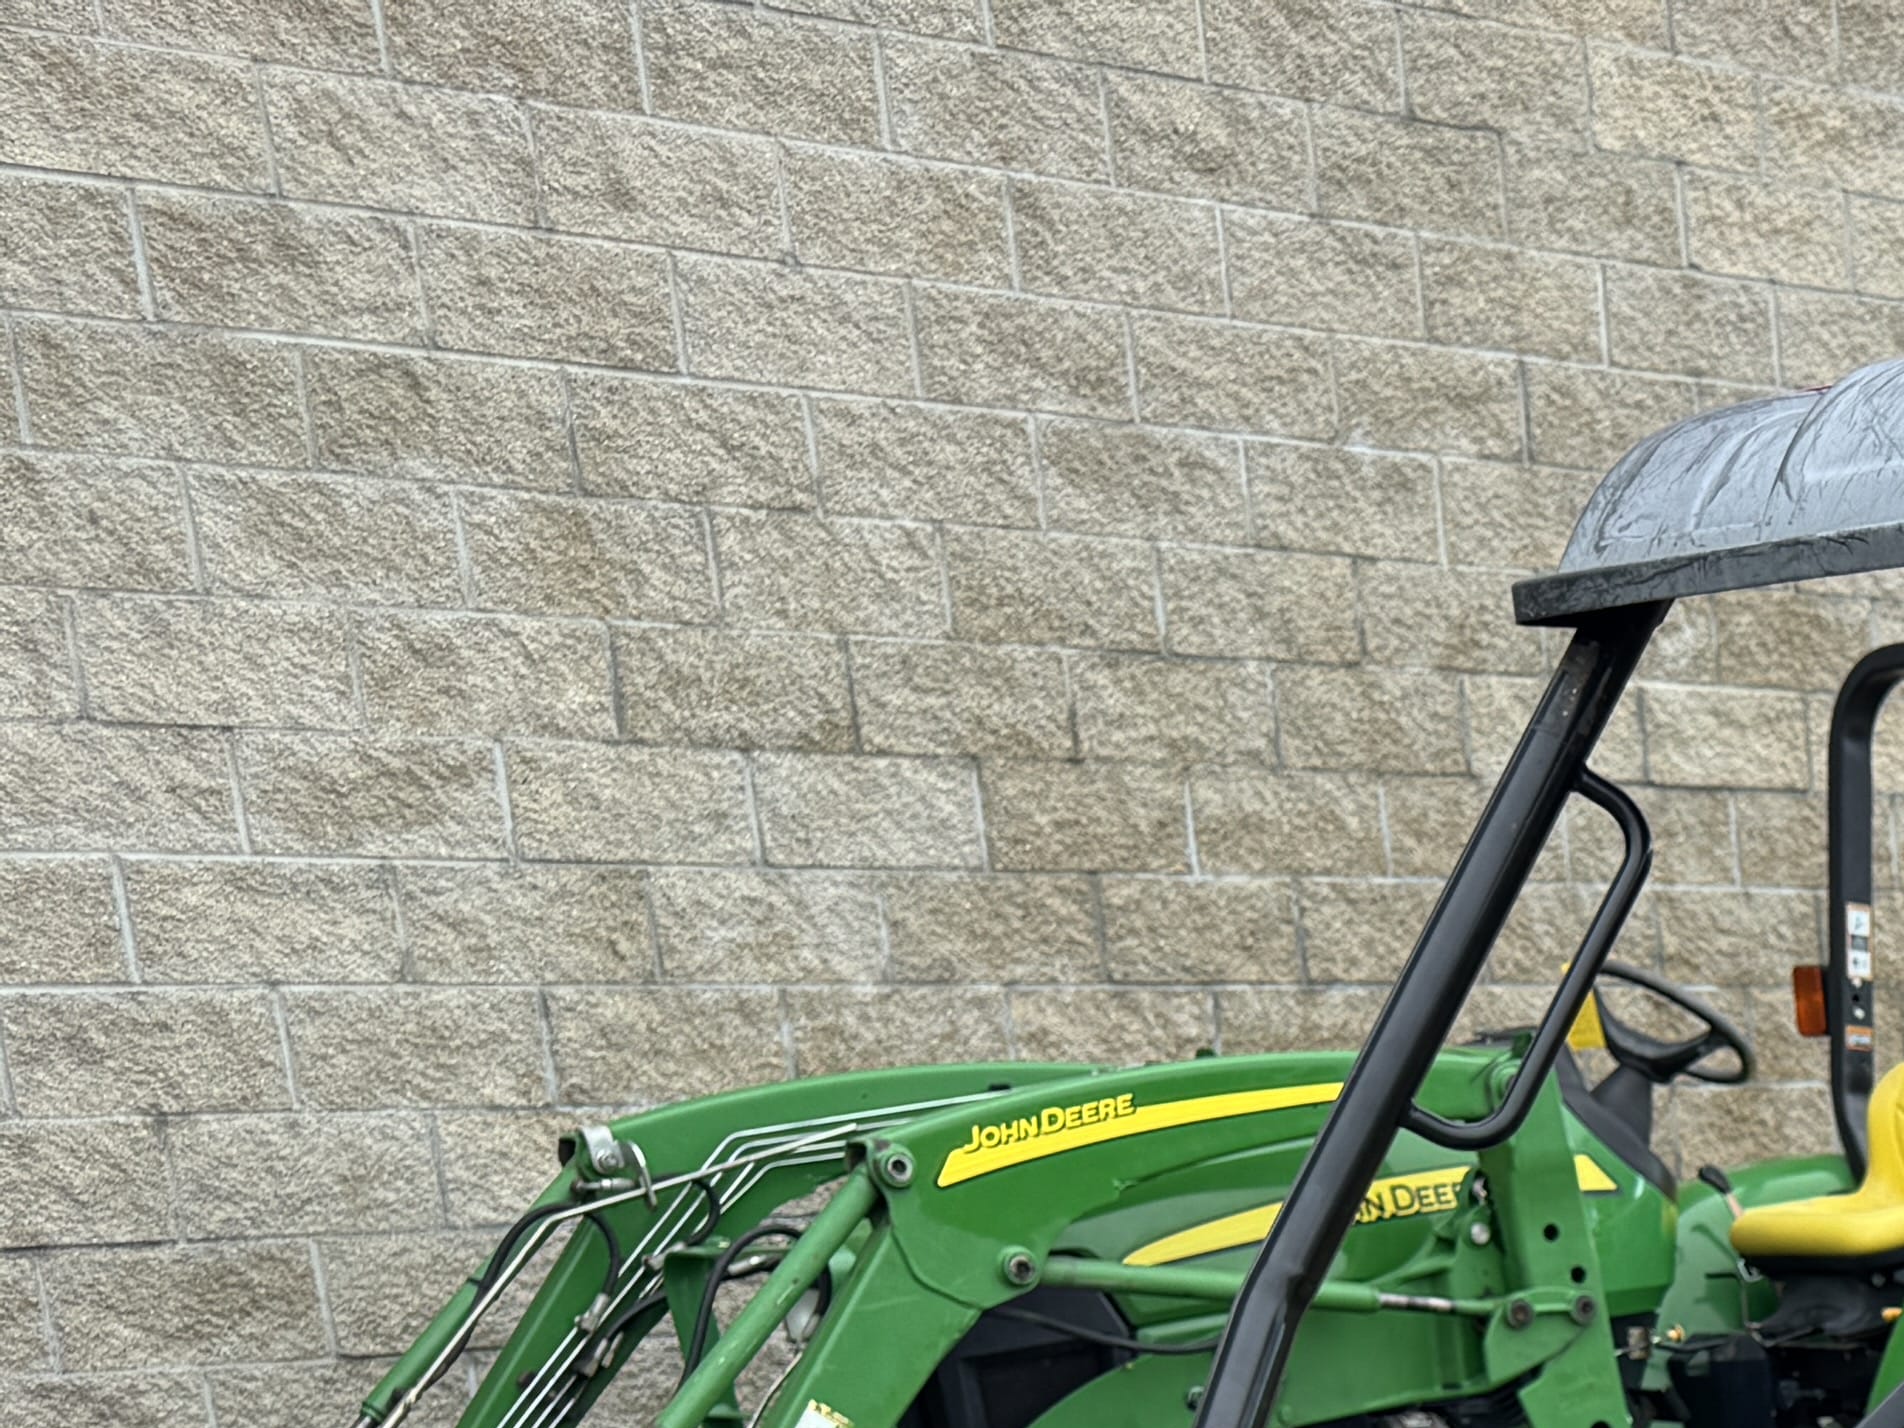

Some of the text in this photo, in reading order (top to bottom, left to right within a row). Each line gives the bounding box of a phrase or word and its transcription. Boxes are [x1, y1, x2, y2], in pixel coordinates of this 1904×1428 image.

[962, 1092, 1135, 1154] JOHN DEERE
[1390, 1183, 1463, 1212] DEE
